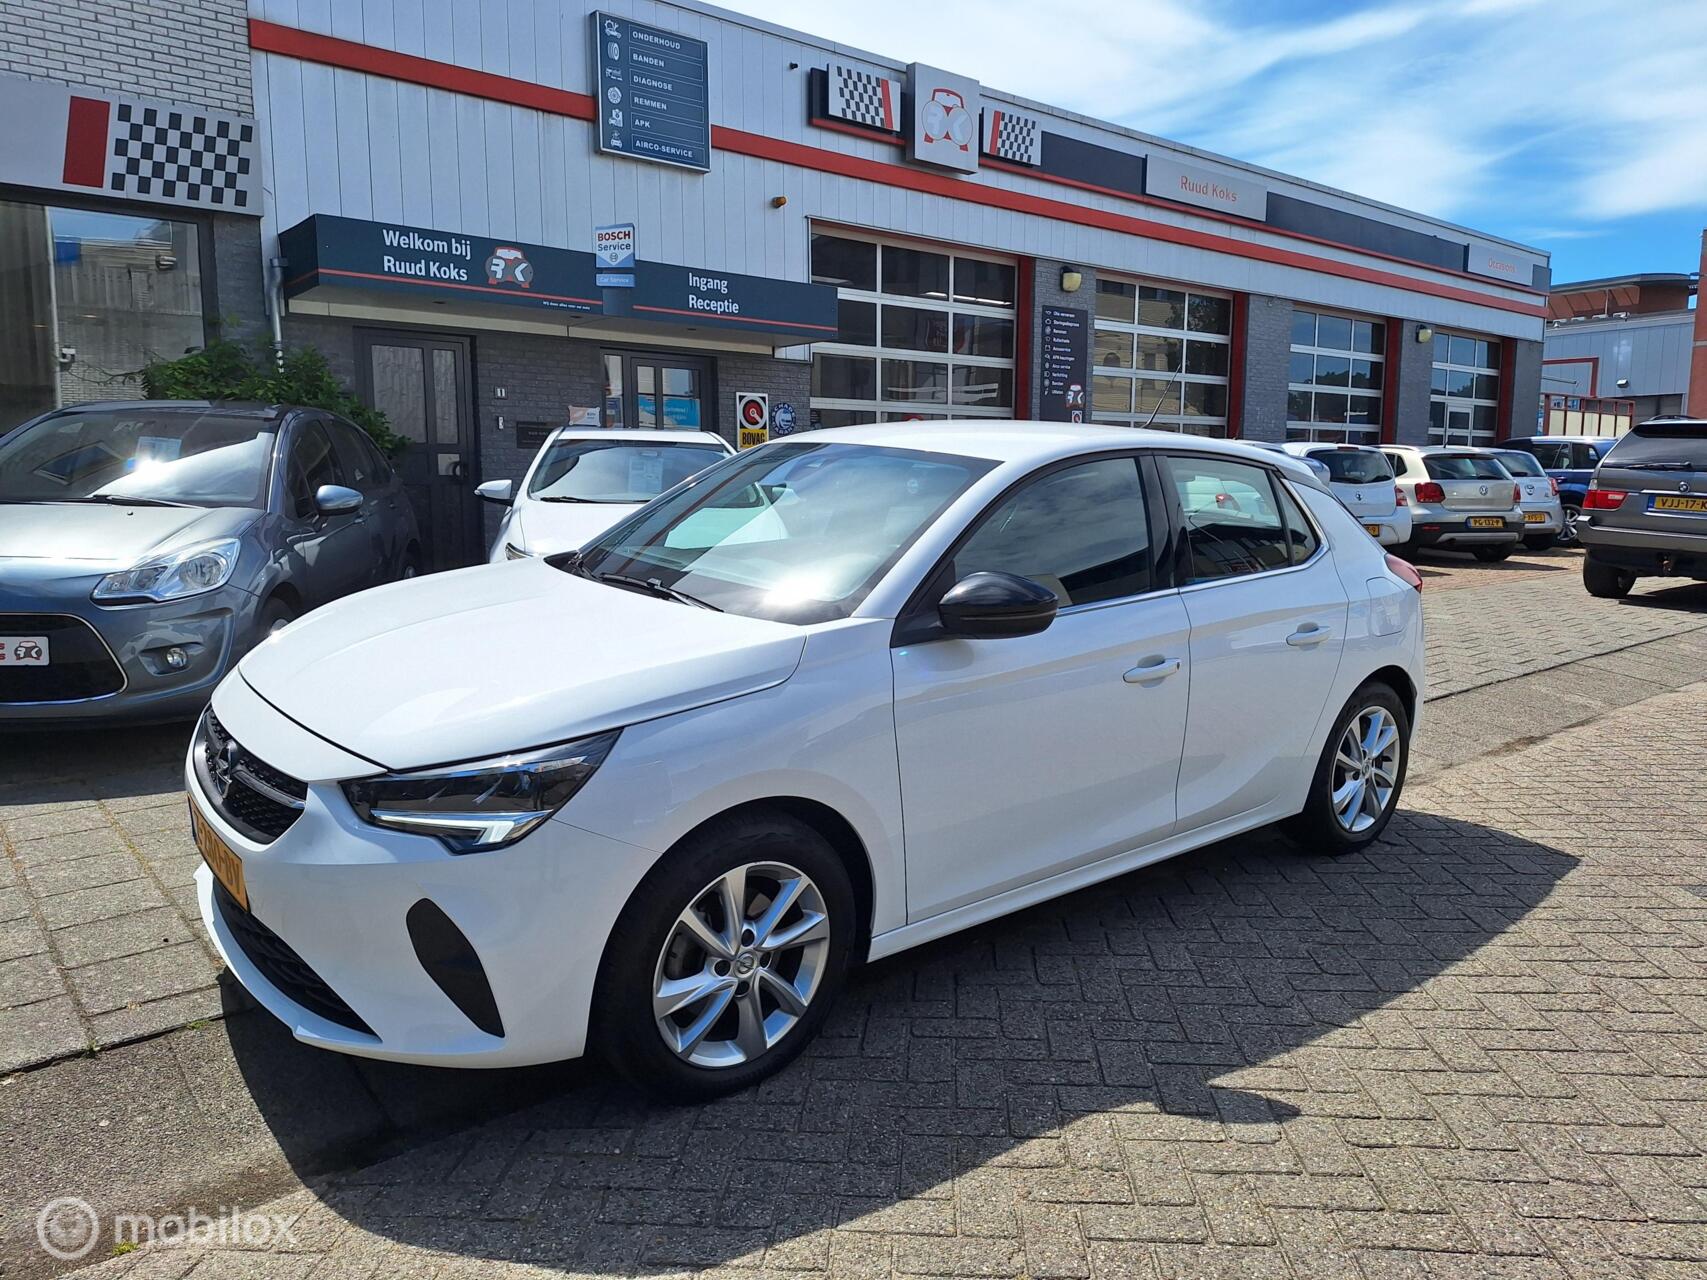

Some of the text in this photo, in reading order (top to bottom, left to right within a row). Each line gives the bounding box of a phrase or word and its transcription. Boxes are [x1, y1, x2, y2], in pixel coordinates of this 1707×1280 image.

[632, 31, 681, 50] ONDERHOUD
[632, 53, 665, 67] BANDEN
[633, 75, 673, 91] DIAGNOSE
[634, 96, 667, 110] REMMEN
[634, 119, 650, 128] APK
[635, 140, 693, 158] AIRCO-SERVICE
[1180, 175, 1238, 202] Ruud Koks
[597, 230, 631, 241] BOSCH
[382, 229, 471, 260] Welkom bij
[597, 242, 631, 252] Service
[383, 255, 468, 281] Ruud Koks
[688, 272, 728, 294] Ingang
[688, 294, 739, 315] Receptie
[742, 431, 765, 445] BOVAG
